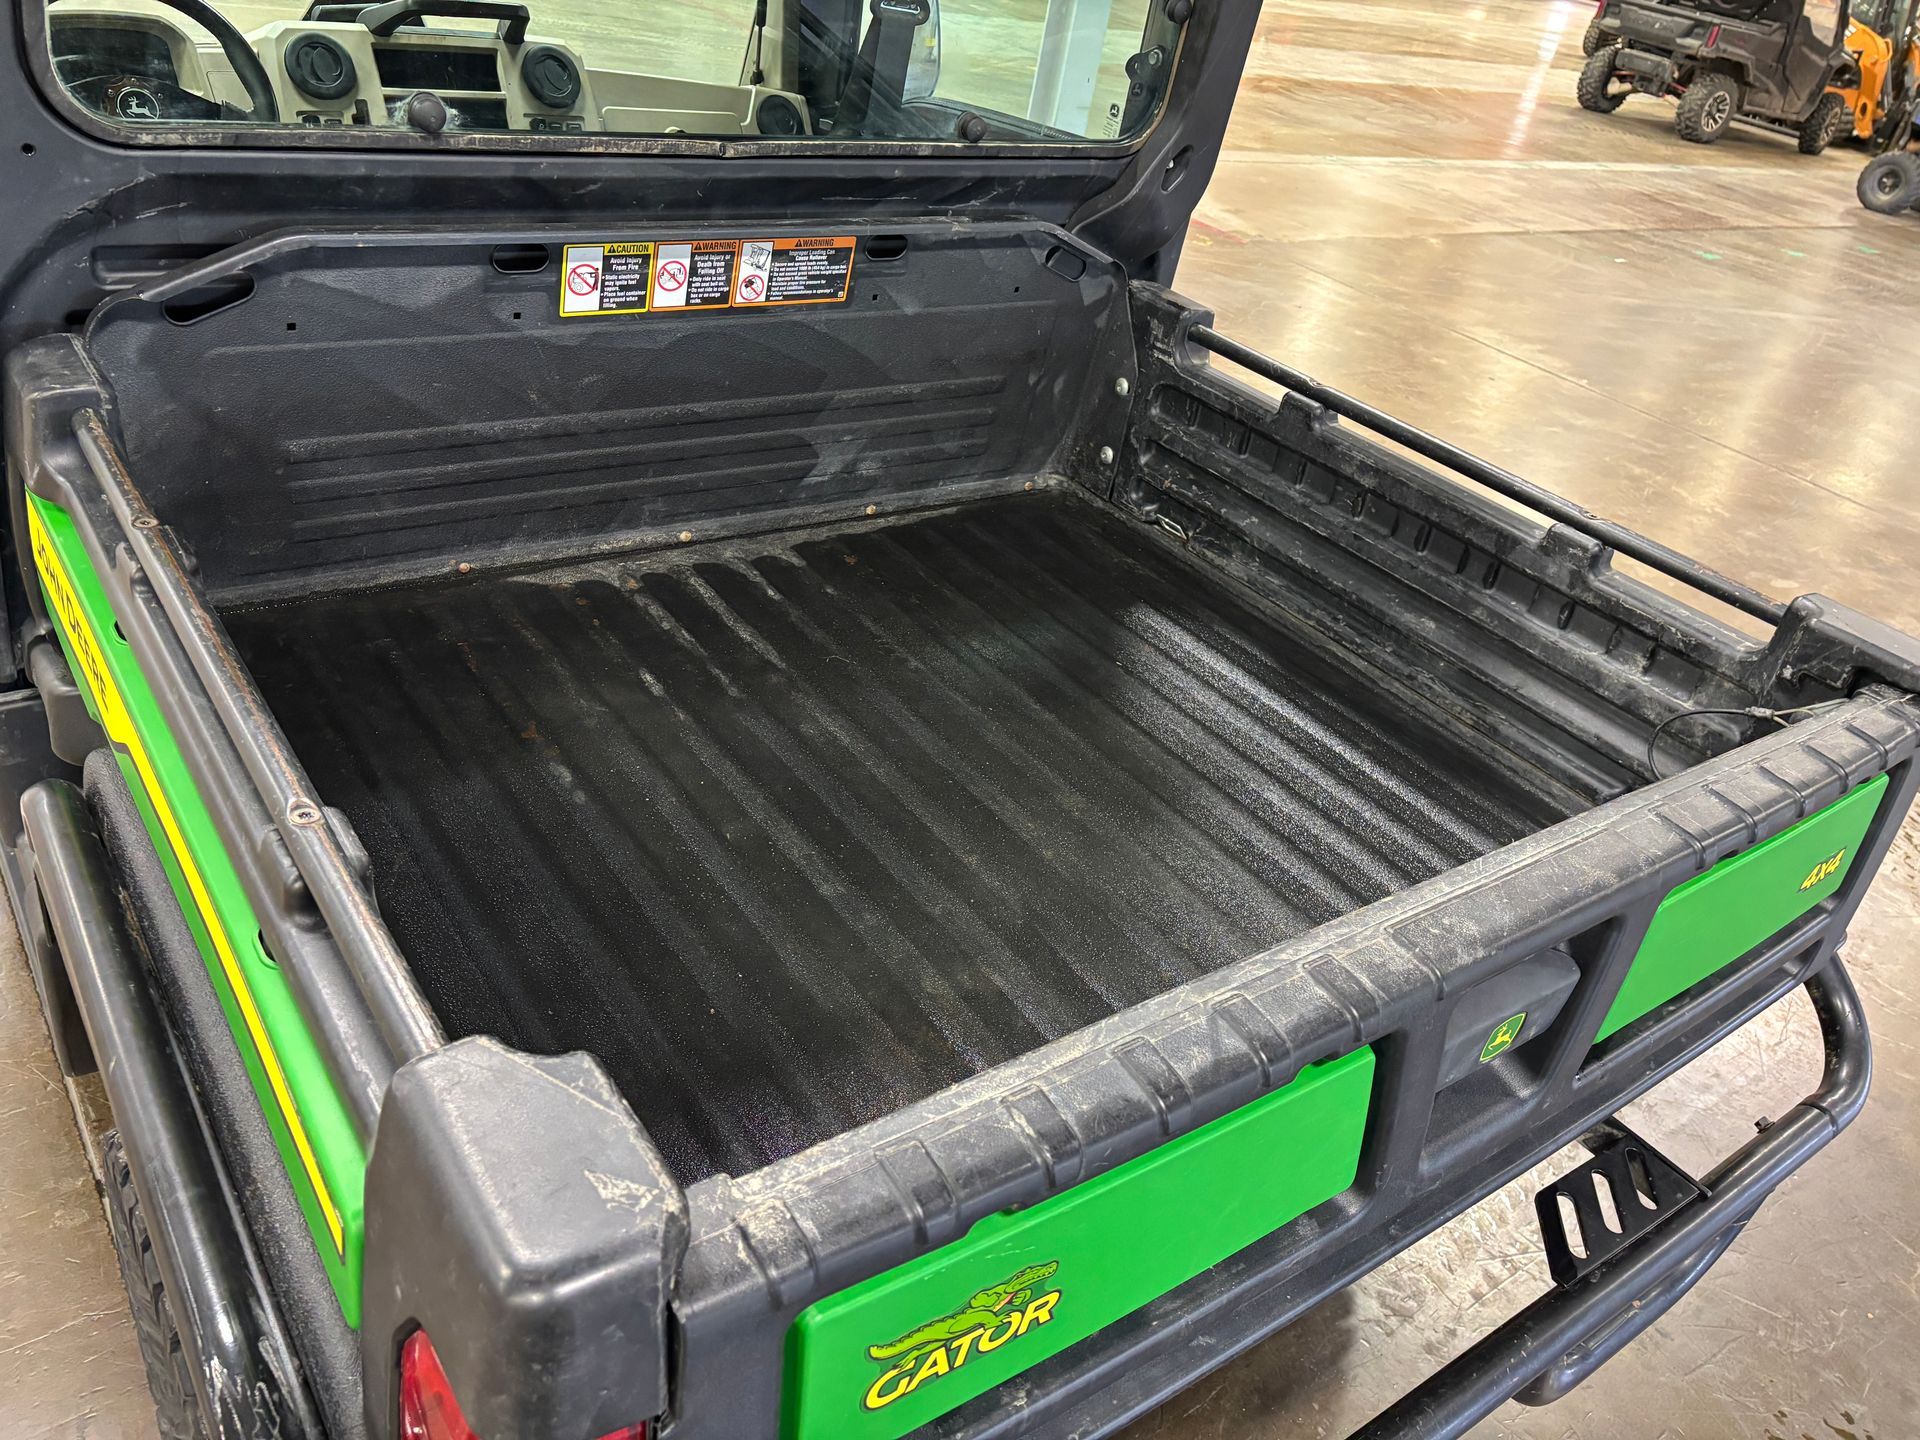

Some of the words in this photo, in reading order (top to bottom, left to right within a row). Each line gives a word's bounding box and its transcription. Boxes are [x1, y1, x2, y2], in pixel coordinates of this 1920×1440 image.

[703, 242, 736, 250] WARNING
[37, 528, 66, 613] JOHN
[65, 590, 109, 713] DEERE
[864, 1290, 1061, 1410] GATOR
